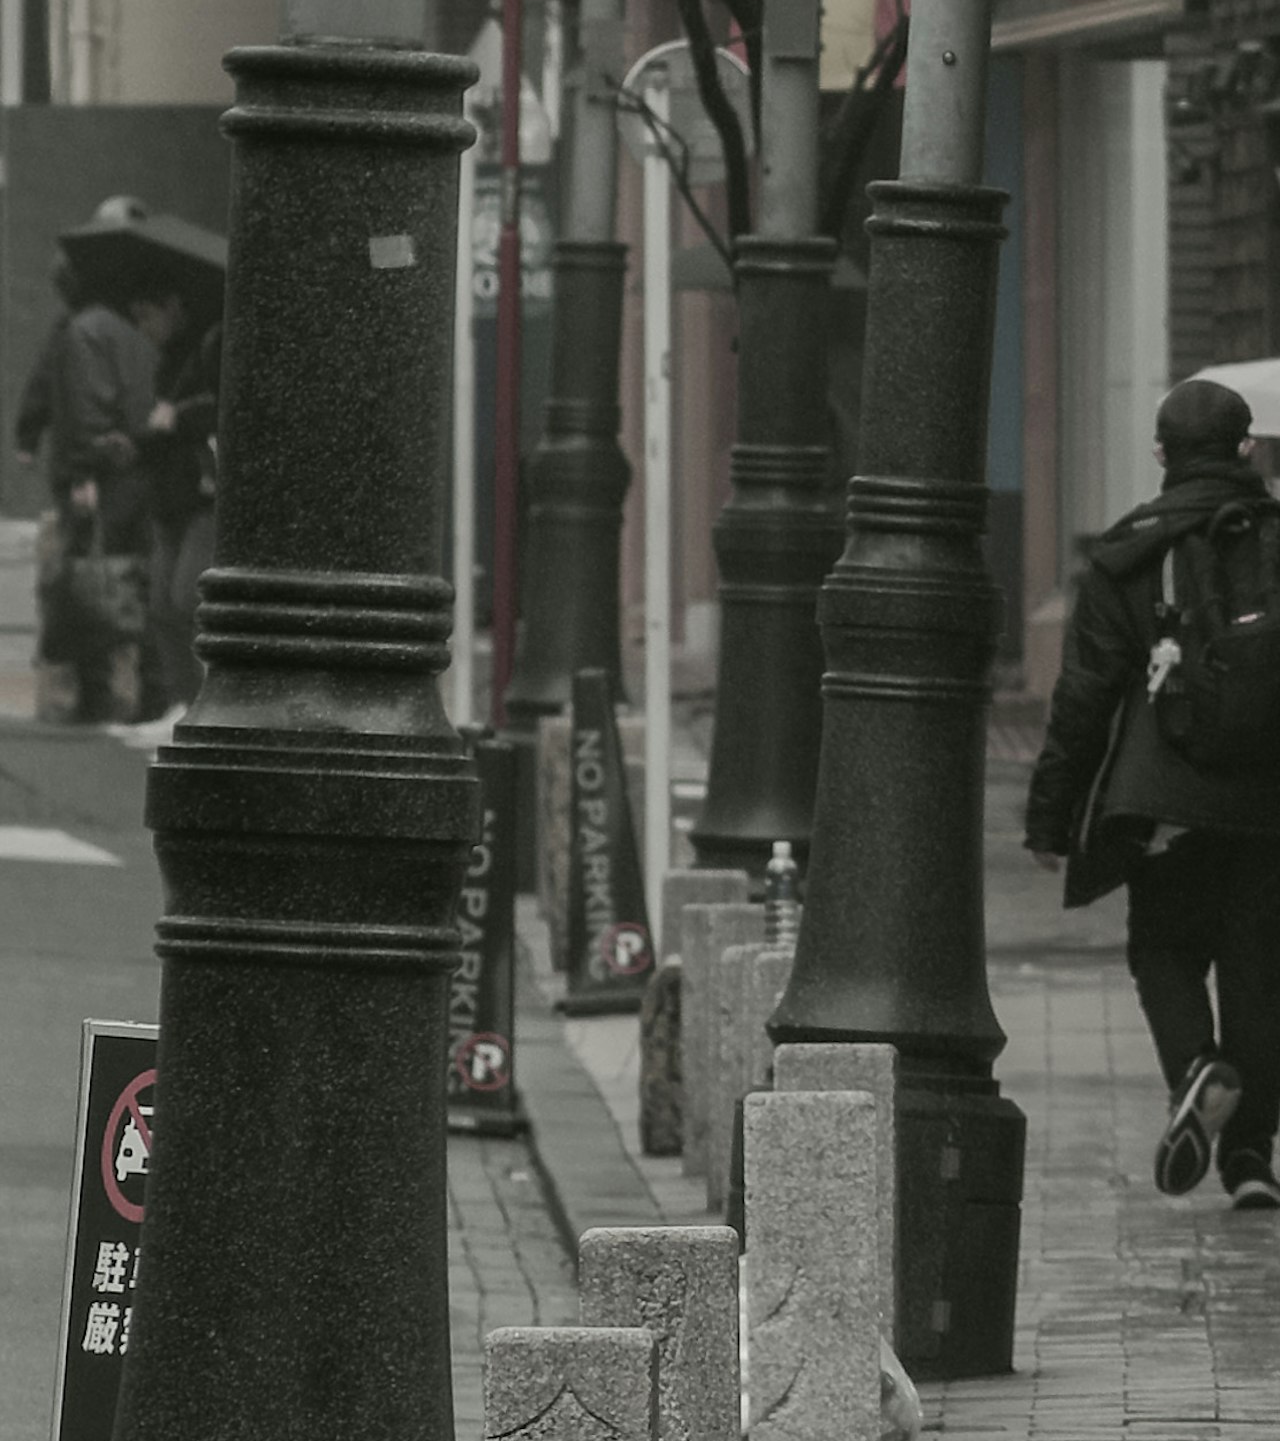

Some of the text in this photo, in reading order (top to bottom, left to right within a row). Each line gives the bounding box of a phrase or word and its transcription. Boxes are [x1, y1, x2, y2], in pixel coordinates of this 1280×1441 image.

[575, 731, 605, 792] NO
[93, 1241, 140, 1294] 駐
[82, 1301, 133, 1355] 厳
